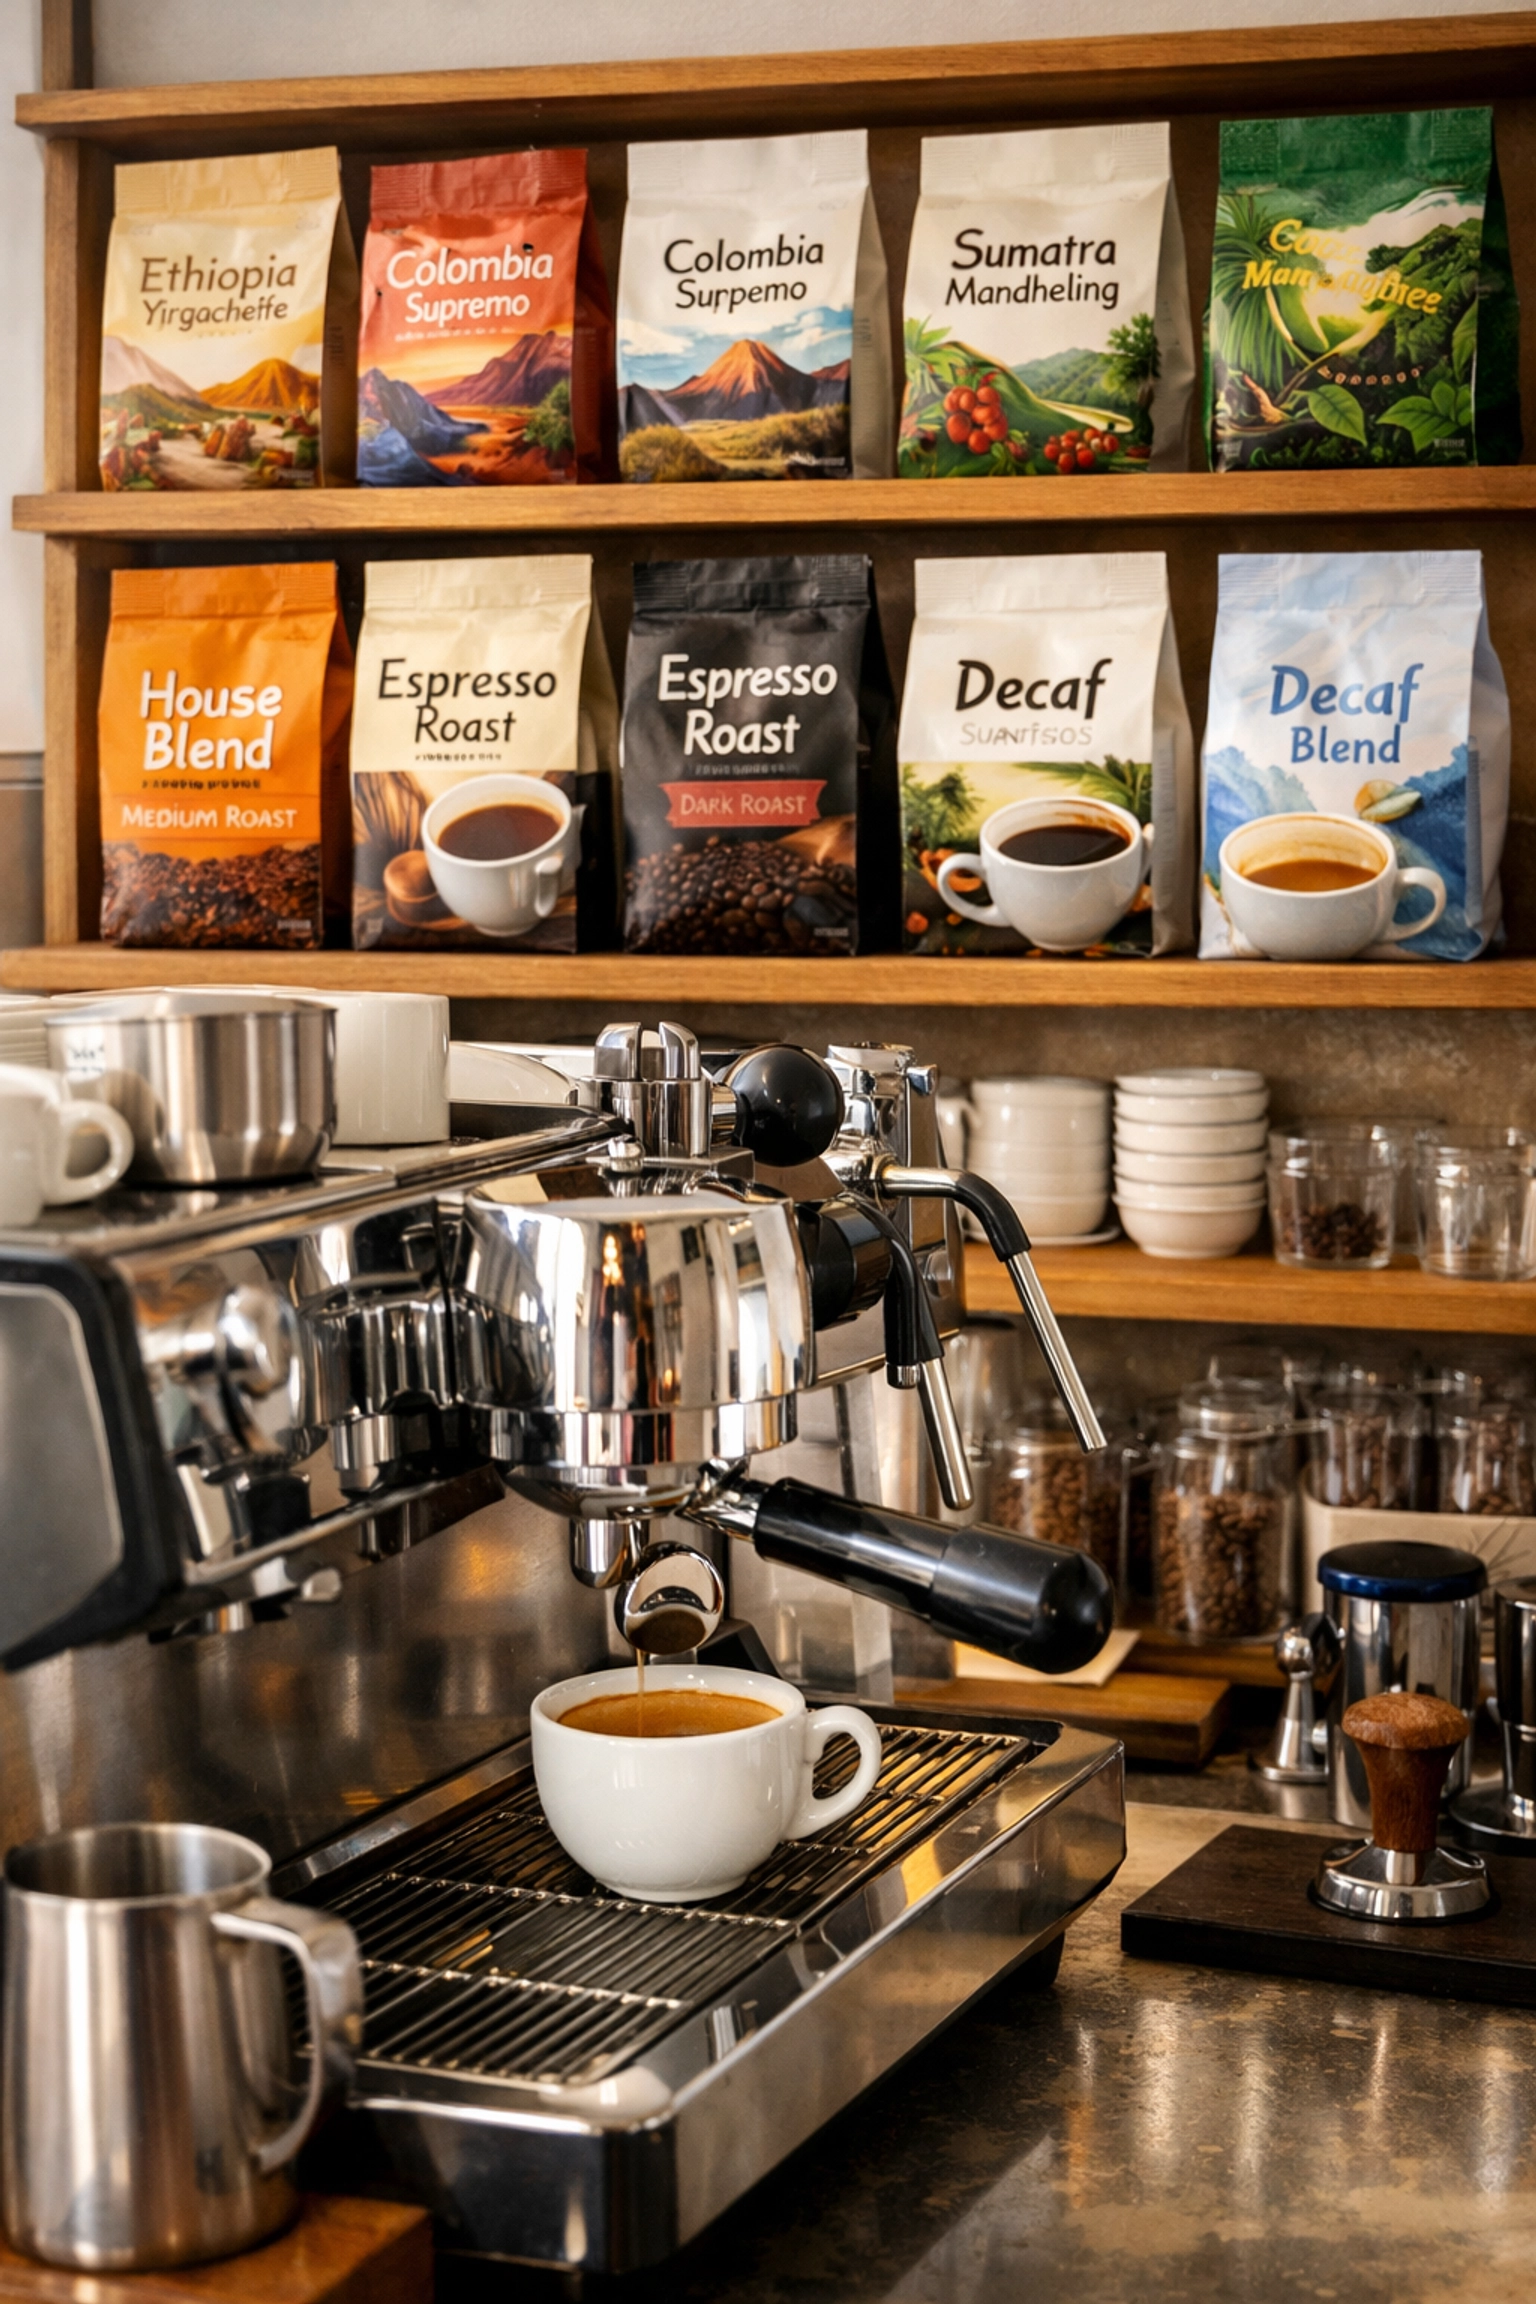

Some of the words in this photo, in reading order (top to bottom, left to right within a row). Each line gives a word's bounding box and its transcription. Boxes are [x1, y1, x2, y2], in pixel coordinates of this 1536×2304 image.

[386, 243, 554, 290] Colombia
[663, 233, 824, 274] Colombia
[951, 228, 1116, 270] Sumatra
[140, 254, 297, 299] Ethiopia
[945, 272, 1119, 310] Mandheling
[405, 292, 531, 328] Supremo
[140, 669, 283, 719] House
[378, 658, 557, 706] Espresso
[658, 653, 838, 708] Espresso
[955, 657, 1113, 720] Decaf
[1270, 663, 1424, 724] Decaf
[143, 719, 275, 771] Blend
[414, 704, 517, 744] Roast
[683, 708, 801, 756] Roast
[1291, 723, 1401, 764] Blend
[225, 805, 298, 829] ROAST
[681, 793, 734, 815] DARK
[740, 793, 807, 815] ROAST
